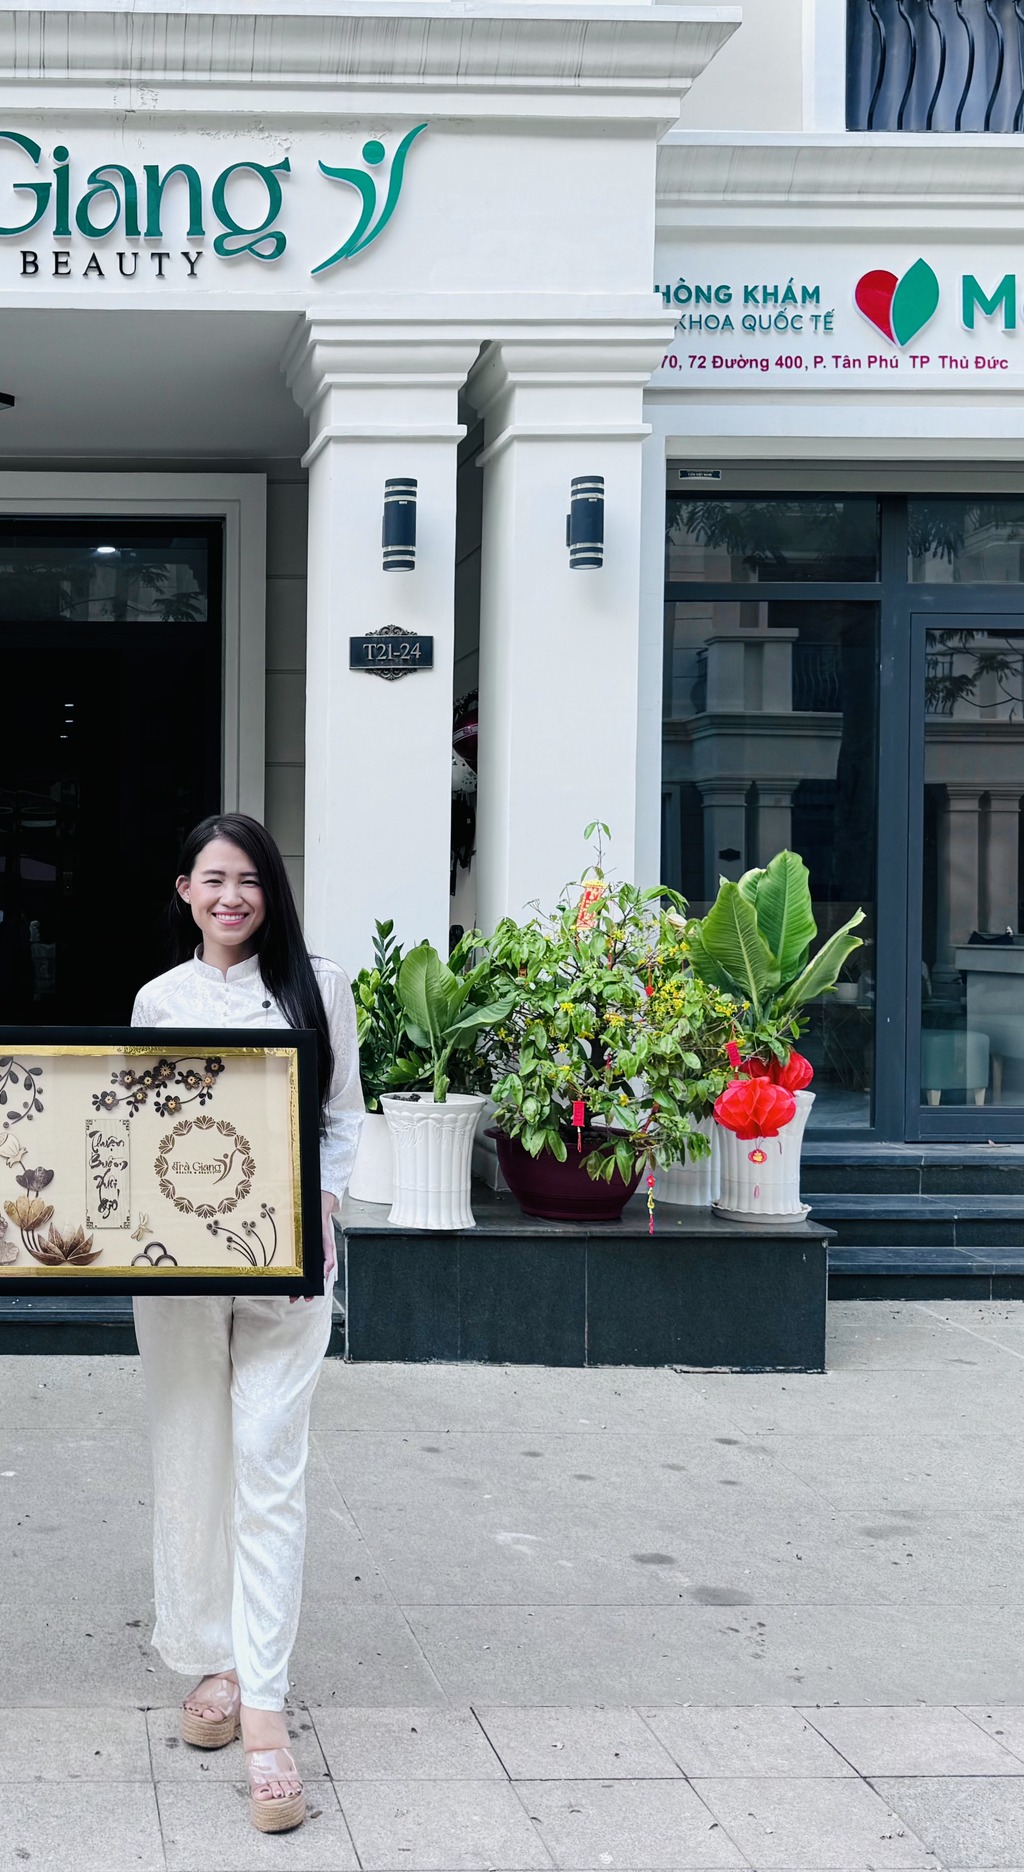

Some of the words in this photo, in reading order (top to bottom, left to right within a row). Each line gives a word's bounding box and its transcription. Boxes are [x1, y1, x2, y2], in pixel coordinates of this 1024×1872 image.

[20, 250, 203, 276] BEAUTY
[743, 277, 820, 304] KHÁM
[742, 308, 804, 331] QUỐC
[810, 308, 835, 331] TẾ
[688, 355, 707, 369] 72
[711, 354, 770, 372] Đường
[774, 355, 809, 371] 400,
[813, 355, 827, 369] P.
[831, 355, 862, 369] Tân
[867, 355, 899, 369] Phú
[909, 355, 930, 369] TP
[938, 355, 969, 370] Thủ
[974, 355, 1009, 370] Đức
[362, 642, 422, 660] T21-24
[192, 1161, 222, 1174] Giang
